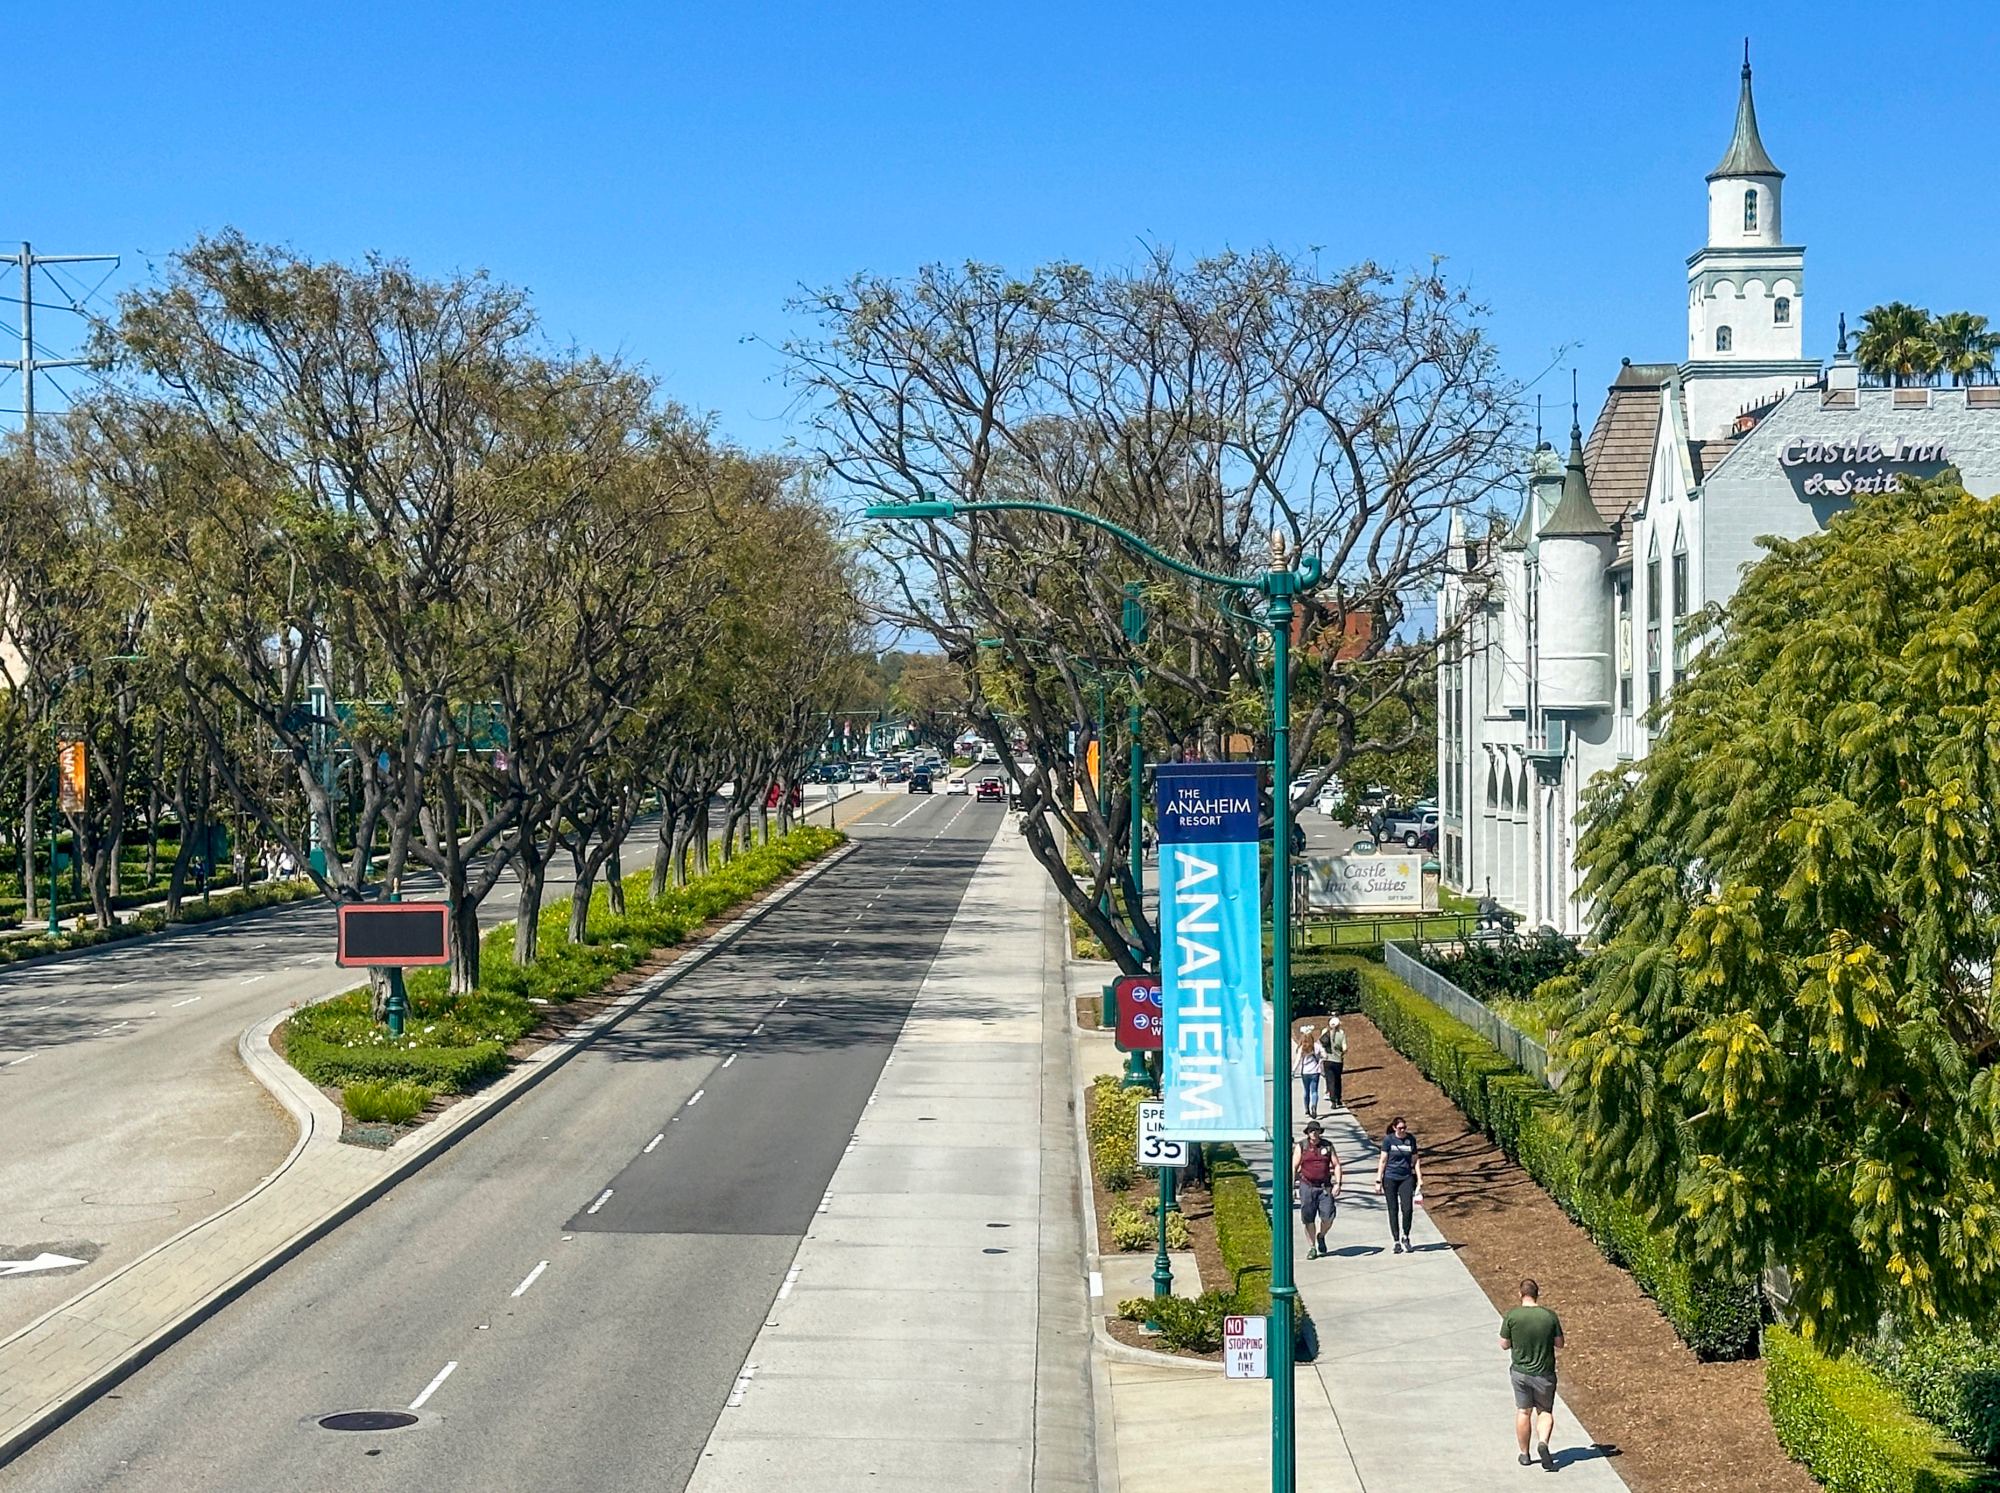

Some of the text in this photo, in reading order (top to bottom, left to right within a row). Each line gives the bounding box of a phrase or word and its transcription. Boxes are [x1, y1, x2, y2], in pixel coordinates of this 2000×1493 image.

[1781, 433, 1949, 466] Castle Inn
[1804, 468, 1904, 496] & Suit
[1178, 789, 1200, 799] THE
[1165, 799, 1251, 815] ANAHEIM
[1180, 815, 1222, 826] RESORT
[1343, 862, 1386, 879] Castle
[1325, 880, 1346, 893] Inn
[1364, 879, 1407, 893] Suites
[1174, 850, 1223, 1121] ANAHEIM
[1142, 1109, 1165, 1119] SPE
[1146, 1122, 1165, 1132] LIM
[1144, 1135, 1181, 1158] 35
[1228, 1320, 1242, 1334] NO
[1228, 1338, 1262, 1350] STOPPING
[1238, 1352, 1253, 1361] ANY
[1238, 1362, 1254, 1372] TIME
